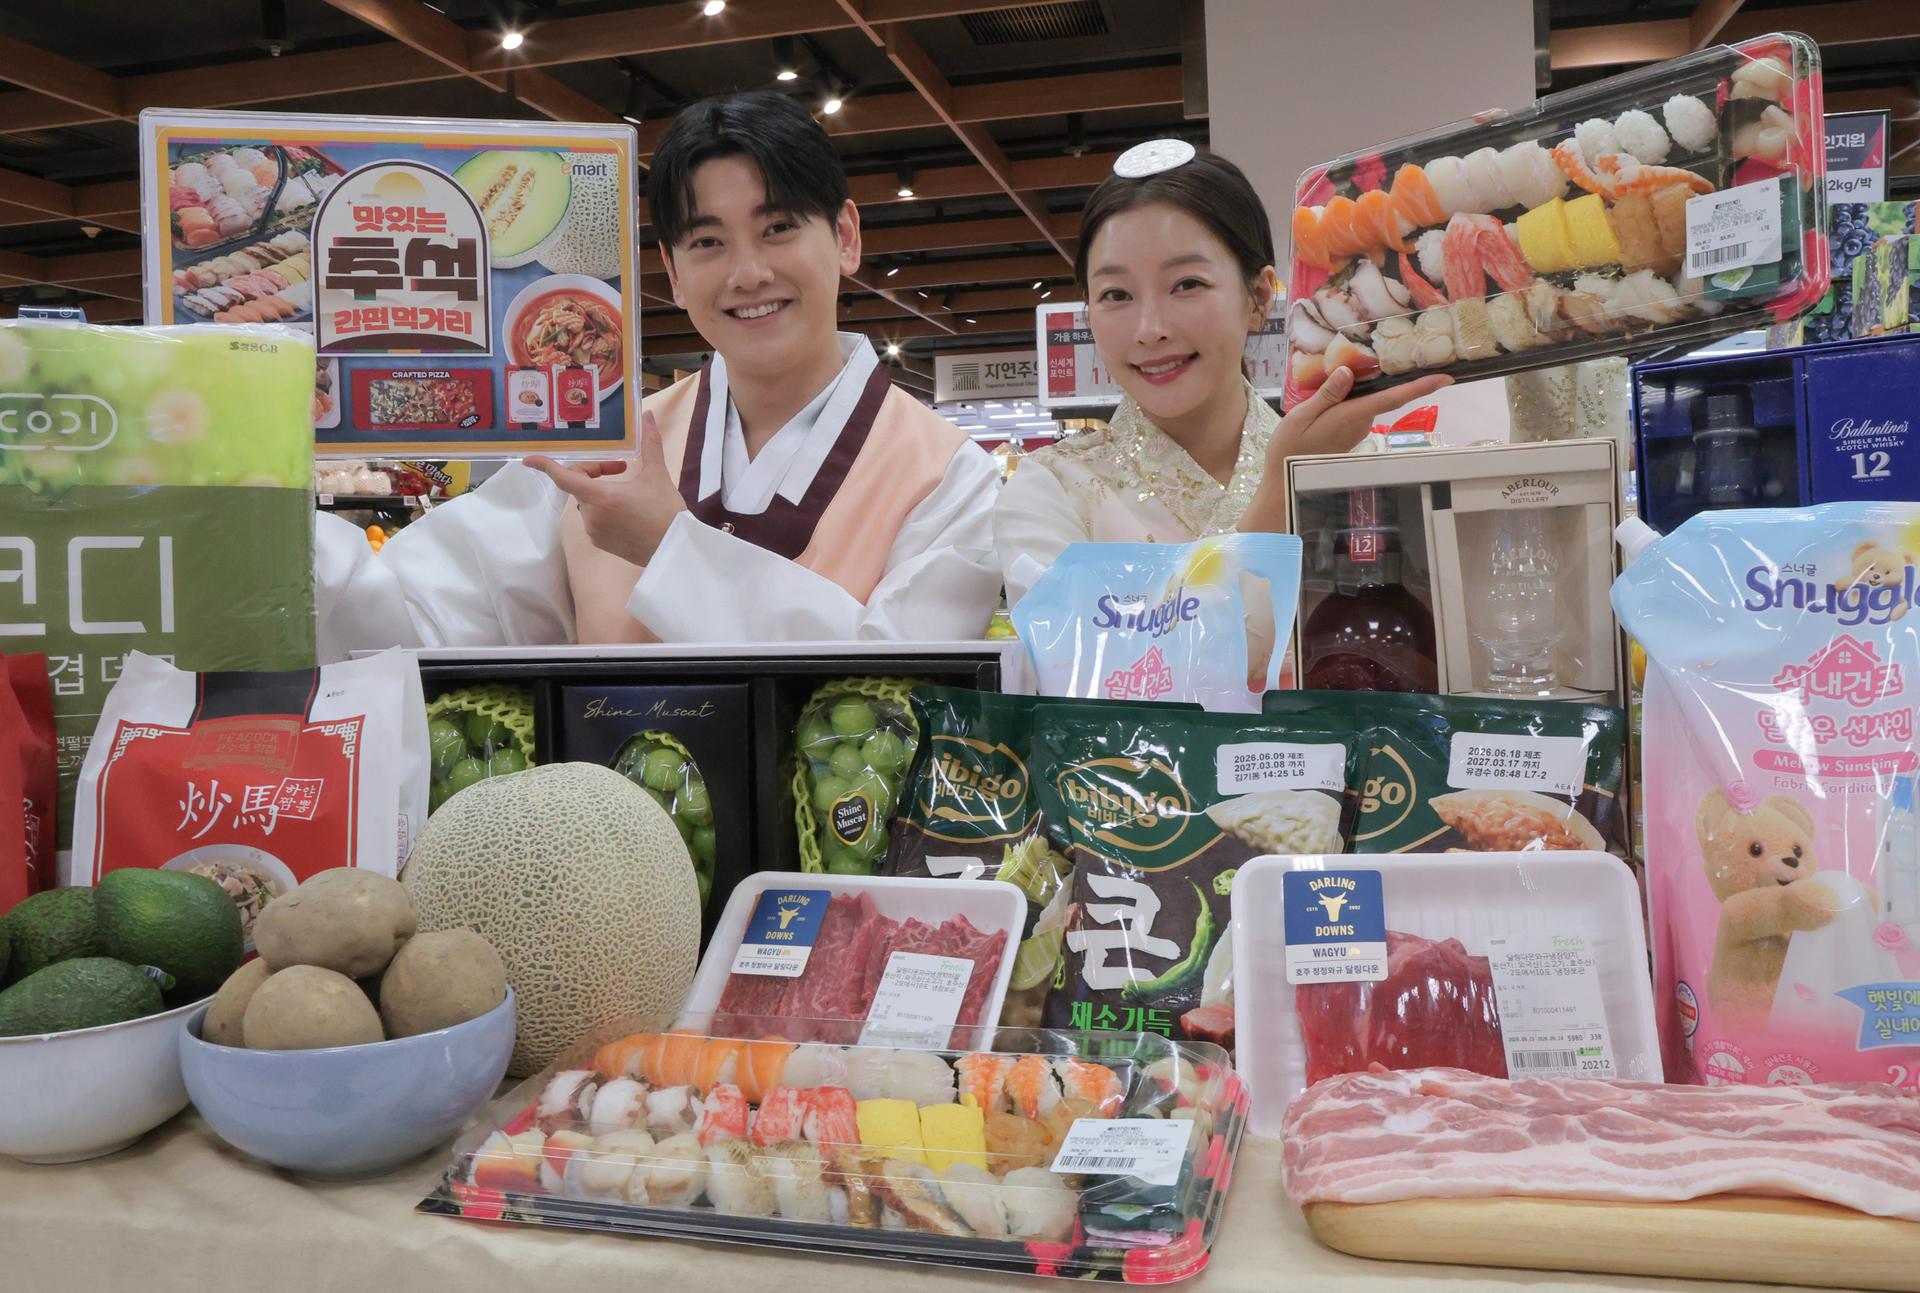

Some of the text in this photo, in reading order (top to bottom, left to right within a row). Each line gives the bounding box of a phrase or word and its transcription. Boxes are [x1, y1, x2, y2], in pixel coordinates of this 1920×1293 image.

[560, 162, 608, 177] emart
[352, 206, 447, 233] 맛있는
[326, 237, 478, 301] 추석
[334, 306, 473, 335] 간편 먹거리
[1054, 332, 1071, 342] 가을
[1050, 358, 1074, 368] 신세계
[391, 371, 451, 379] CRAFTED PIZZA
[1050, 368, 1074, 378] 포인트
[1829, 417, 1909, 440] Ballantine's
[1835, 440, 1905, 452] SCOTCH WHISKY
[1842, 435, 1897, 446] SINGLE MALT
[1850, 450, 1892, 479] 12
[1501, 478, 1560, 499] ABERLOUR
[1510, 496, 1549, 504] DISTILLERY
[1354, 538, 1372, 553] 12
[1781, 562, 1817, 577] 스너글
[1092, 586, 1200, 638] Snuggle
[1773, 663, 1904, 708] 실내건조
[584, 697, 716, 718] Shine Muscat
[1841, 707, 1913, 748] 선샤인
[1234, 752, 1304, 763] 2026.06.09 제조
[1468, 747, 1541, 759] 2026.06.18 제조
[1234, 761, 1306, 772] 2027.03.08 까지
[1467, 757, 1540, 769] 2027.03.17 까지
[1834, 757, 1900, 774] Sunshine
[1263, 770, 1289, 779] 14:25
[1292, 769, 1305, 777] L6
[1466, 768, 1547, 780] 유경수 08:48 L7-2
[285, 783, 317, 798] 하얀
[176, 779, 281, 840] 炒馬
[278, 797, 312, 813] 짬뽕
[1067, 778, 1181, 828] bibigo
[838, 804, 863, 819] Shine
[836, 812, 867, 831] Muscat
[1309, 877, 1357, 891] DARLING
[777, 894, 811, 906] DARLING
[765, 931, 795, 941] DOWNS
[1066, 872, 1182, 991] 큰
[1315, 925, 1355, 937] DOWNS
[756, 947, 782, 956] WAGYU
[1312, 947, 1346, 958] WAGYU
[1295, 964, 1379, 977] 호주 청정와규 달링다운
[1068, 1000, 1173, 1038] 채소가득
[1581, 1060, 1610, 1070] 20212
